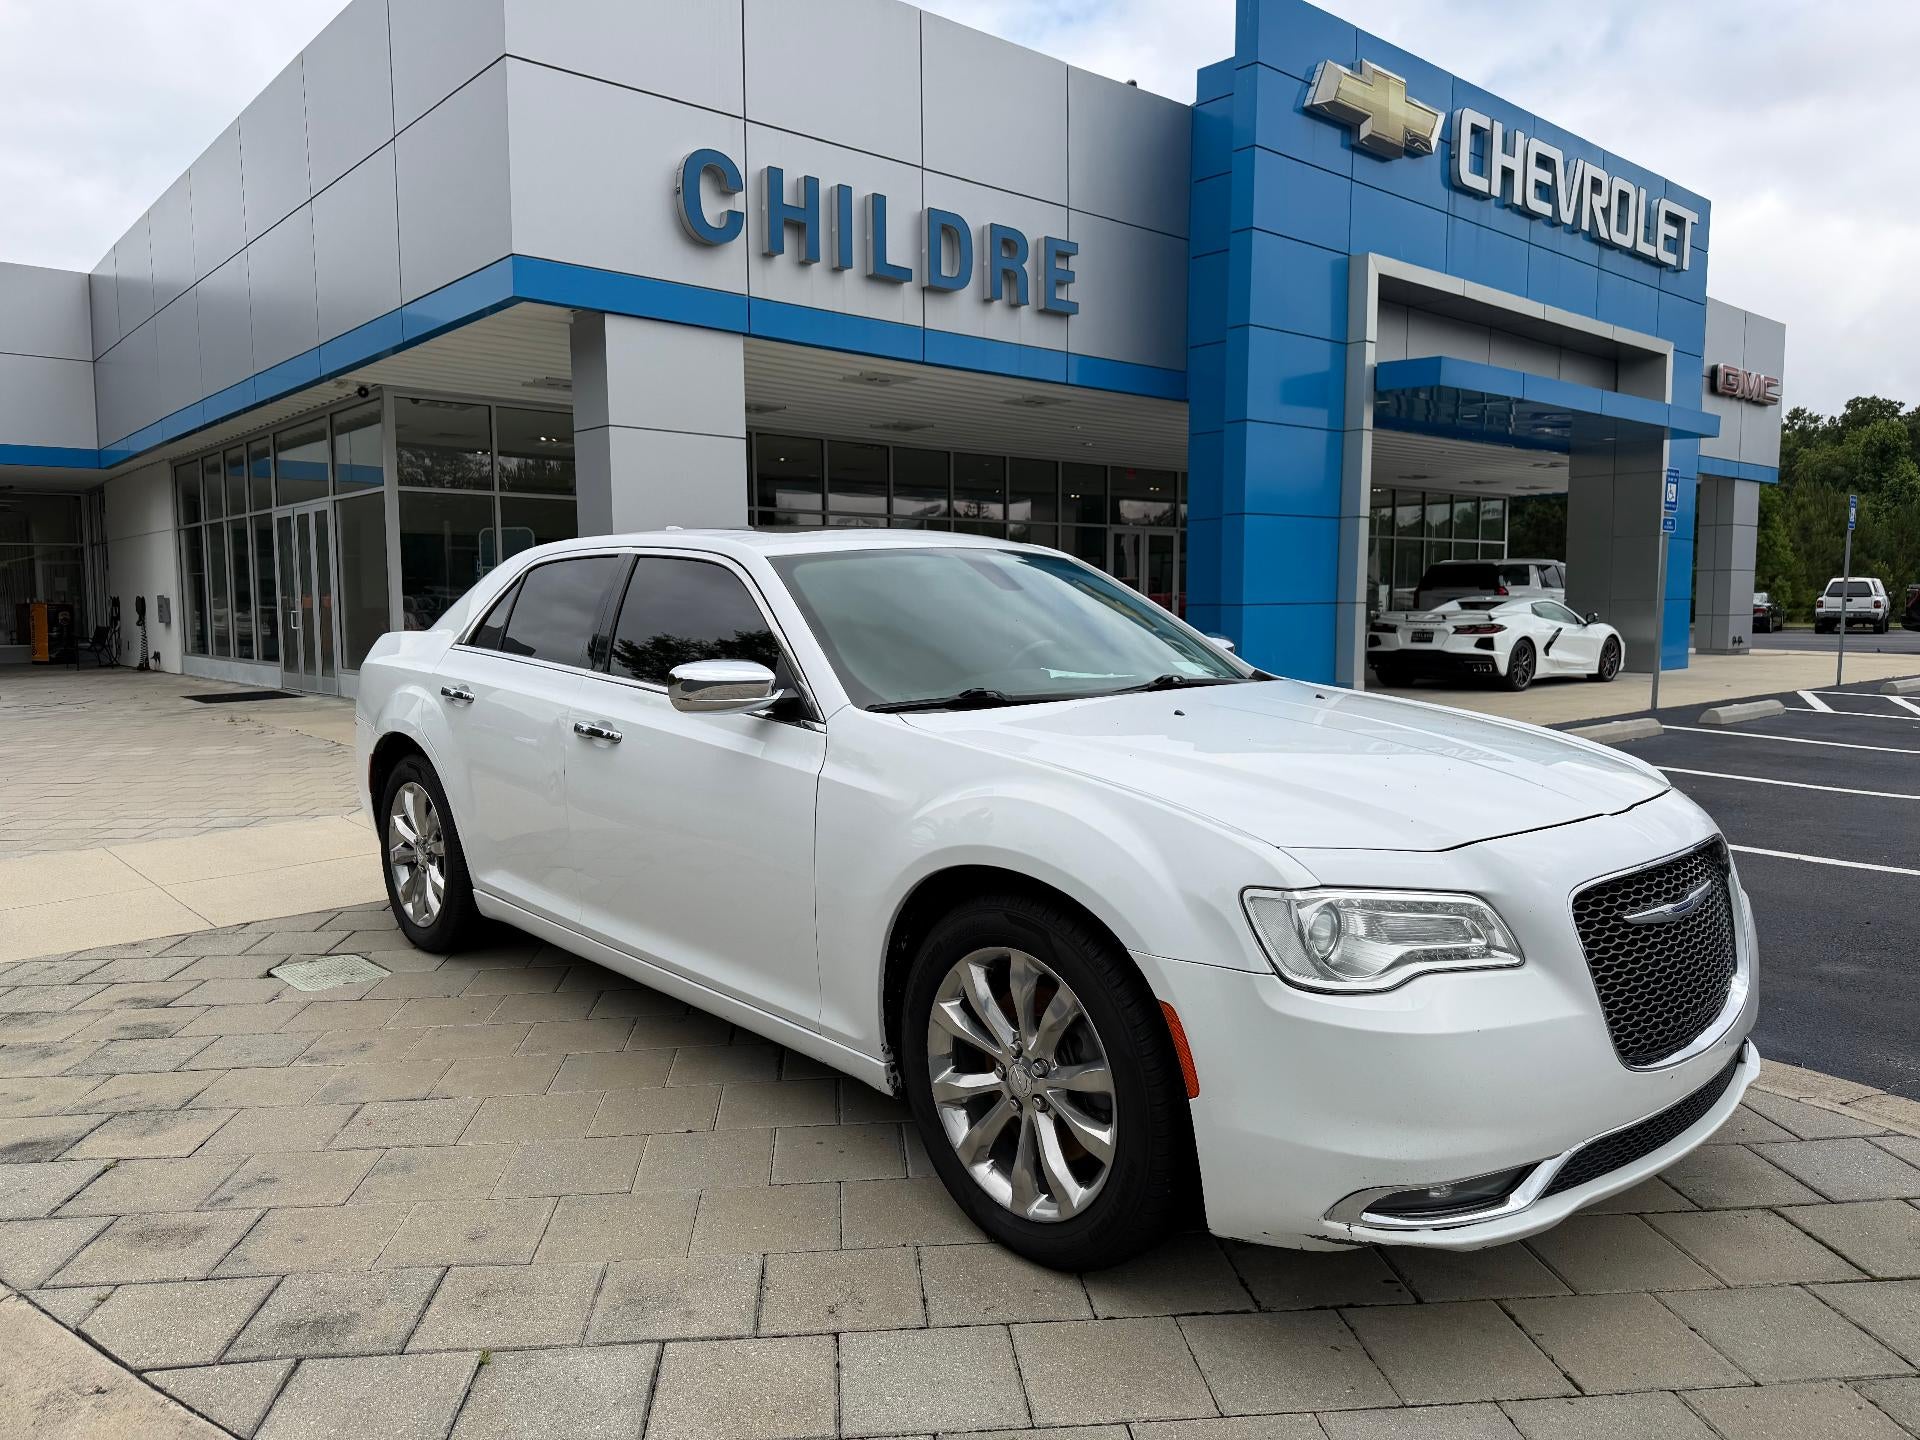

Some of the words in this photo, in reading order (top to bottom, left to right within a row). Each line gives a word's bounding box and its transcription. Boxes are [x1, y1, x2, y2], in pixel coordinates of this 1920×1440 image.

[676, 148, 1079, 315] CHILDRE
[1452, 107, 1699, 271] CHEVROLET
[1715, 363, 1779, 405] GMC
